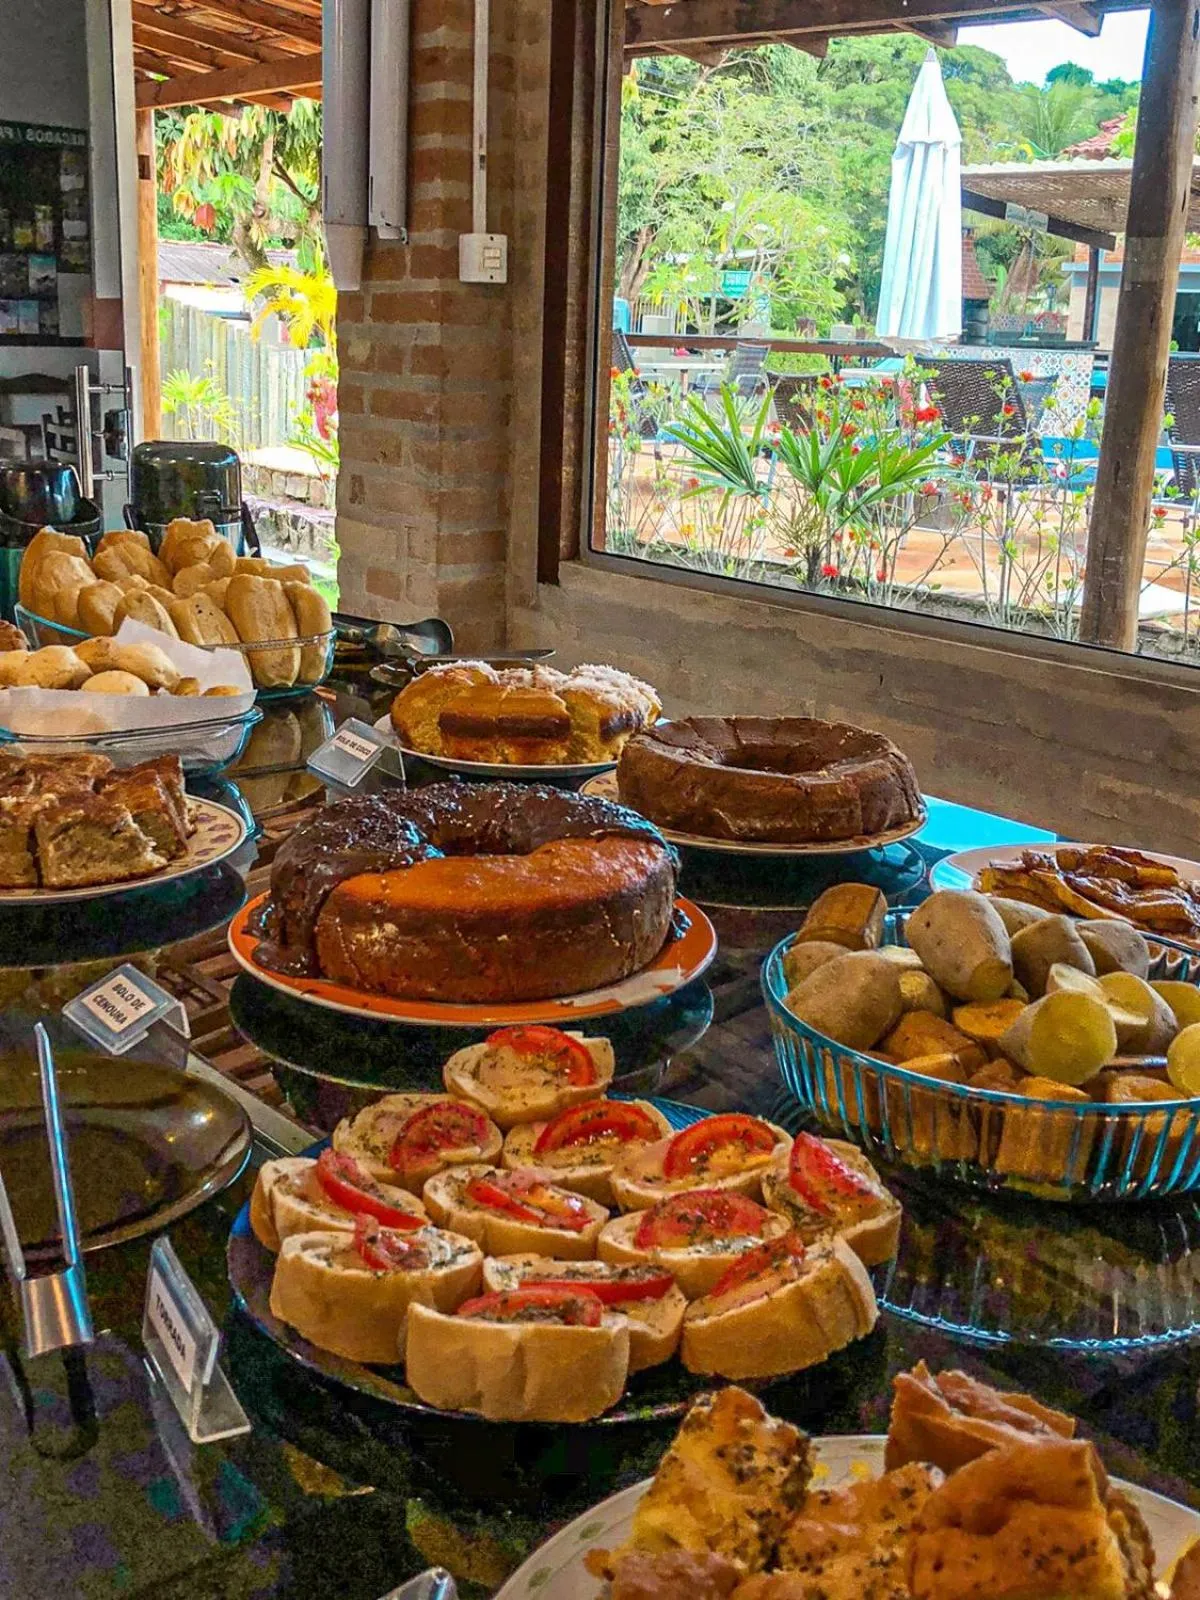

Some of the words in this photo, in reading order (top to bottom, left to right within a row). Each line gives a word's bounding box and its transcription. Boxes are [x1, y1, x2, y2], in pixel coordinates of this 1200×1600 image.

[92, 994, 129, 1024] CENOURA
[112, 983, 135, 1003] BOLO
[130, 997, 146, 1011] DE
[155, 1293, 186, 1361] TORRADA
